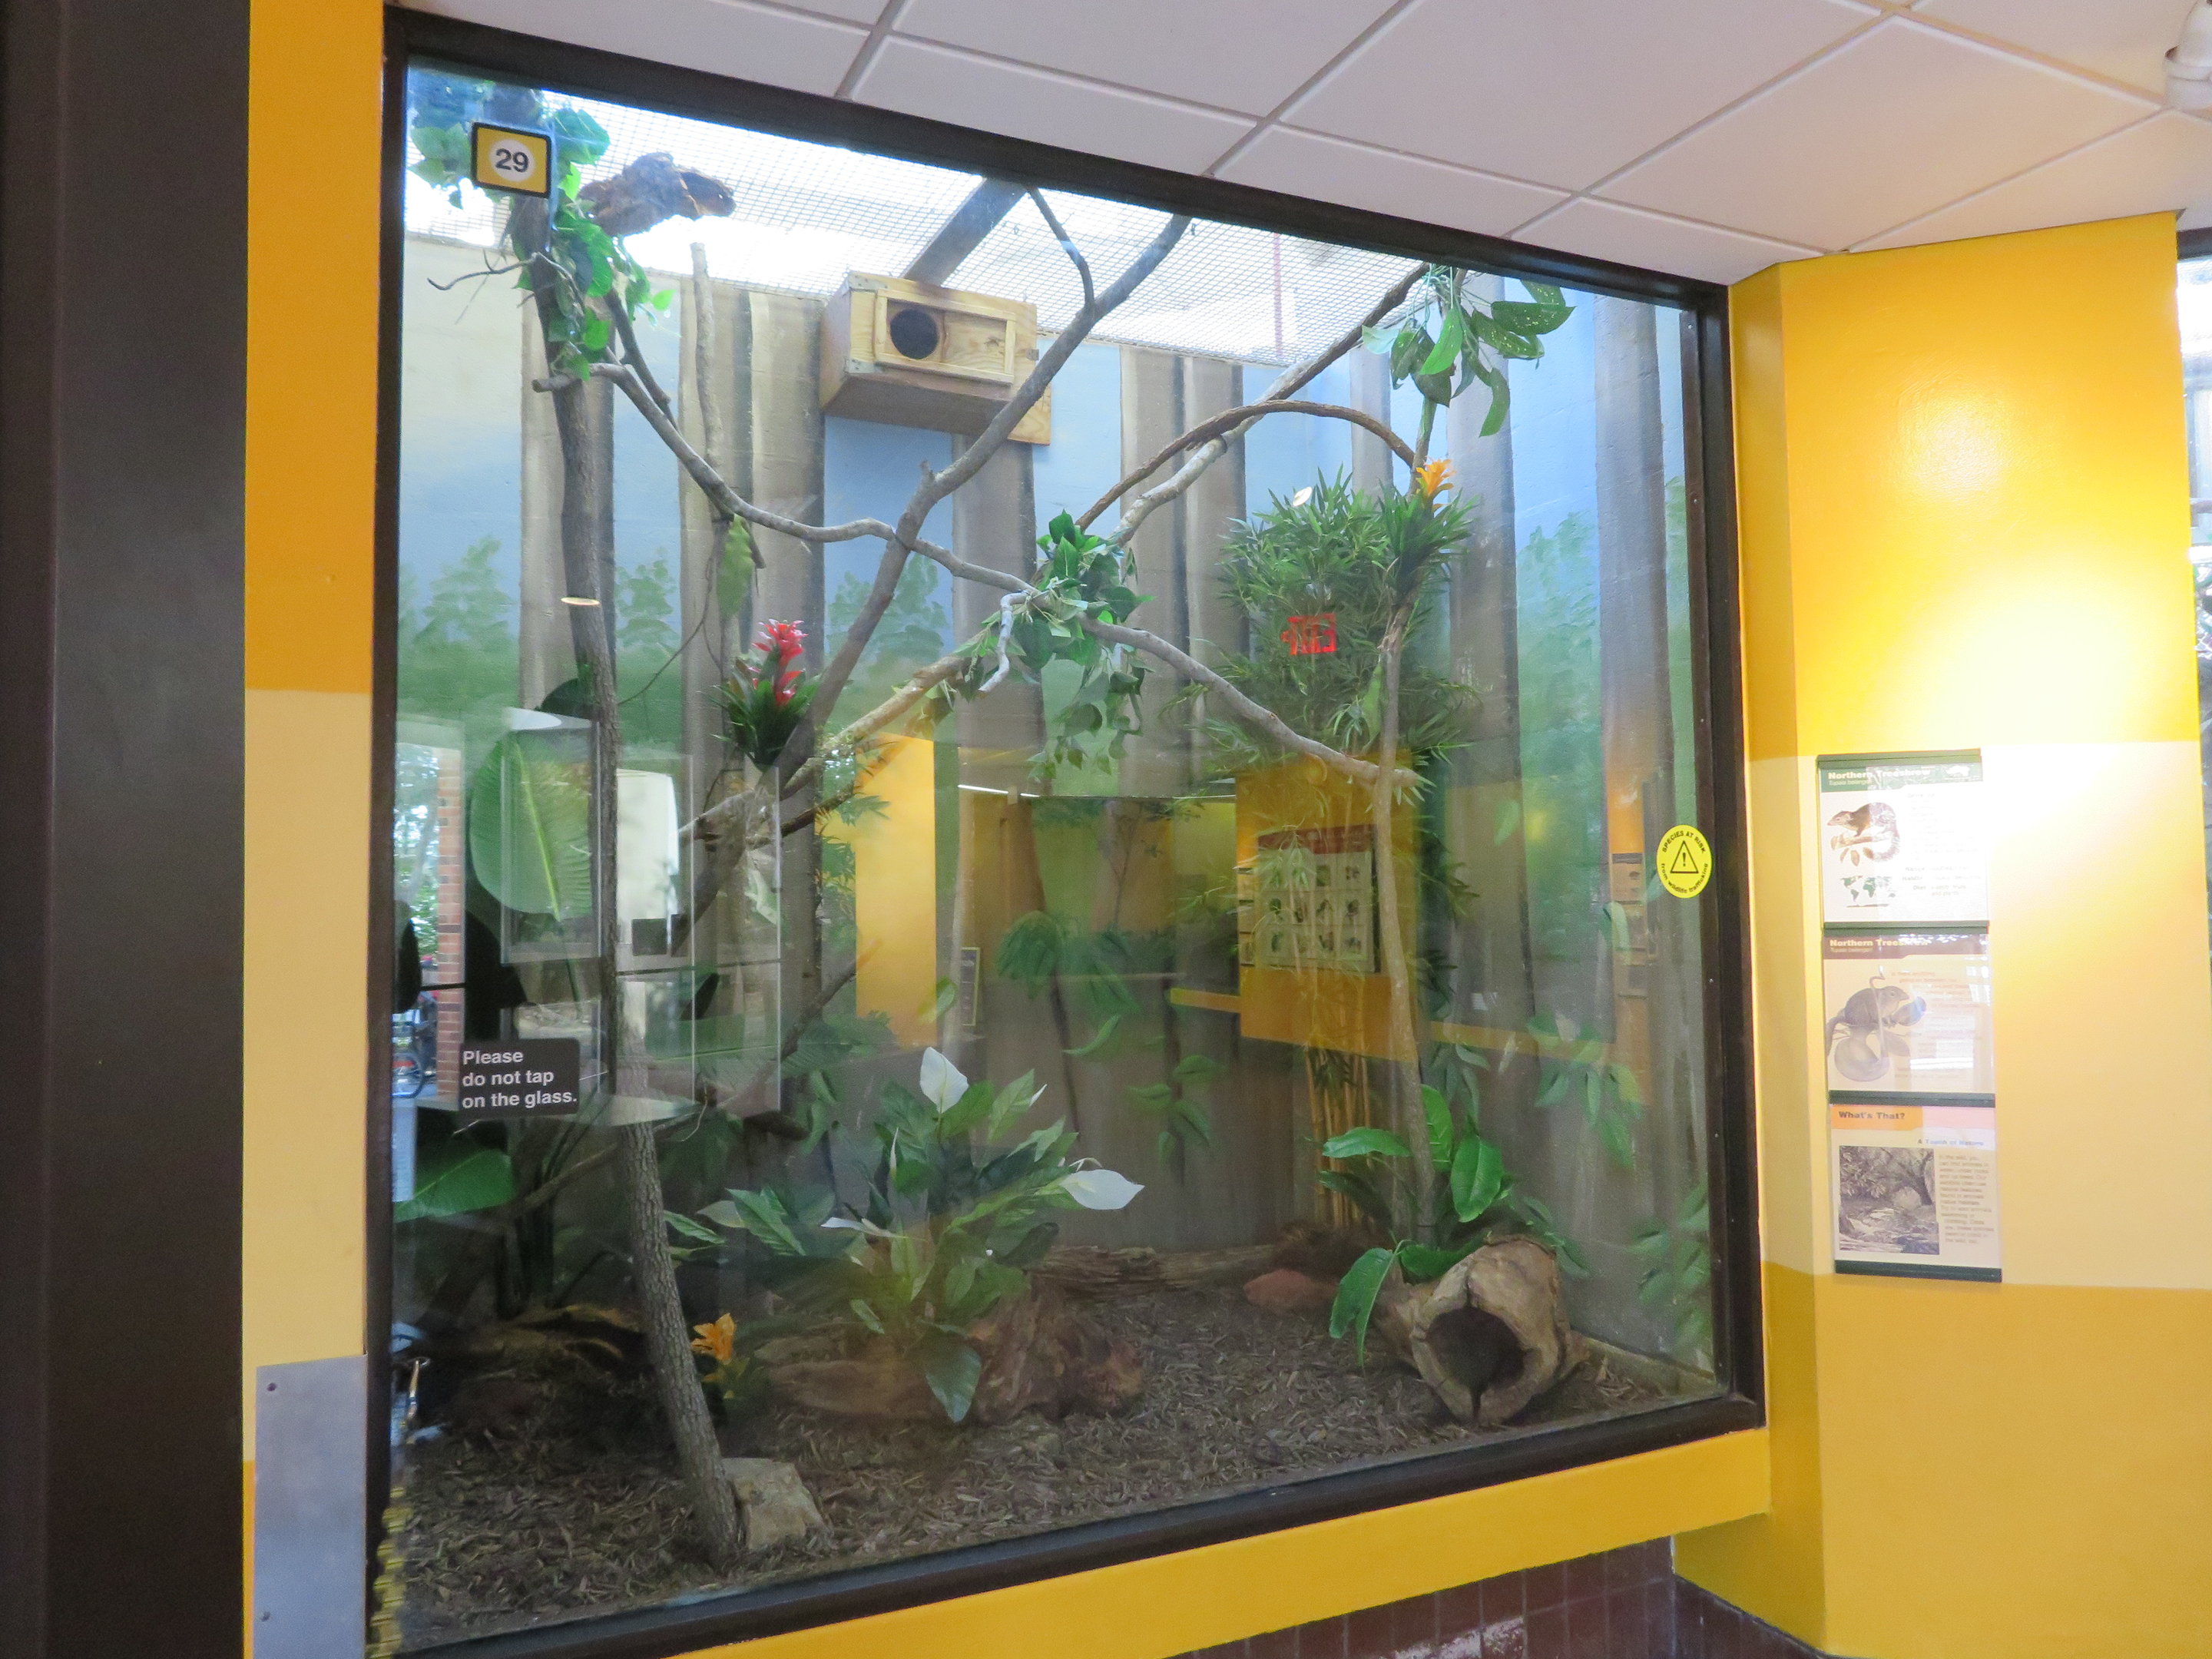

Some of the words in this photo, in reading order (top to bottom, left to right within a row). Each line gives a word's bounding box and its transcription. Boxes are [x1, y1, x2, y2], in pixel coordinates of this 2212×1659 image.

[495, 148, 528, 173] 29
[1828, 770, 1873, 780] Northern
[1662, 830, 1684, 853] SPECIES
[1694, 836, 1706, 853] RISK
[462, 1050, 524, 1065] Please
[462, 1072, 485, 1087] do
[491, 1071, 522, 1085] not
[525, 1070, 555, 1086] tap
[462, 1096, 485, 1109] on
[491, 1092, 520, 1107] the
[525, 1090, 578, 1108] glass.
[1838, 1111, 1873, 1119] What's
[1876, 1111, 1906, 1120] That?
